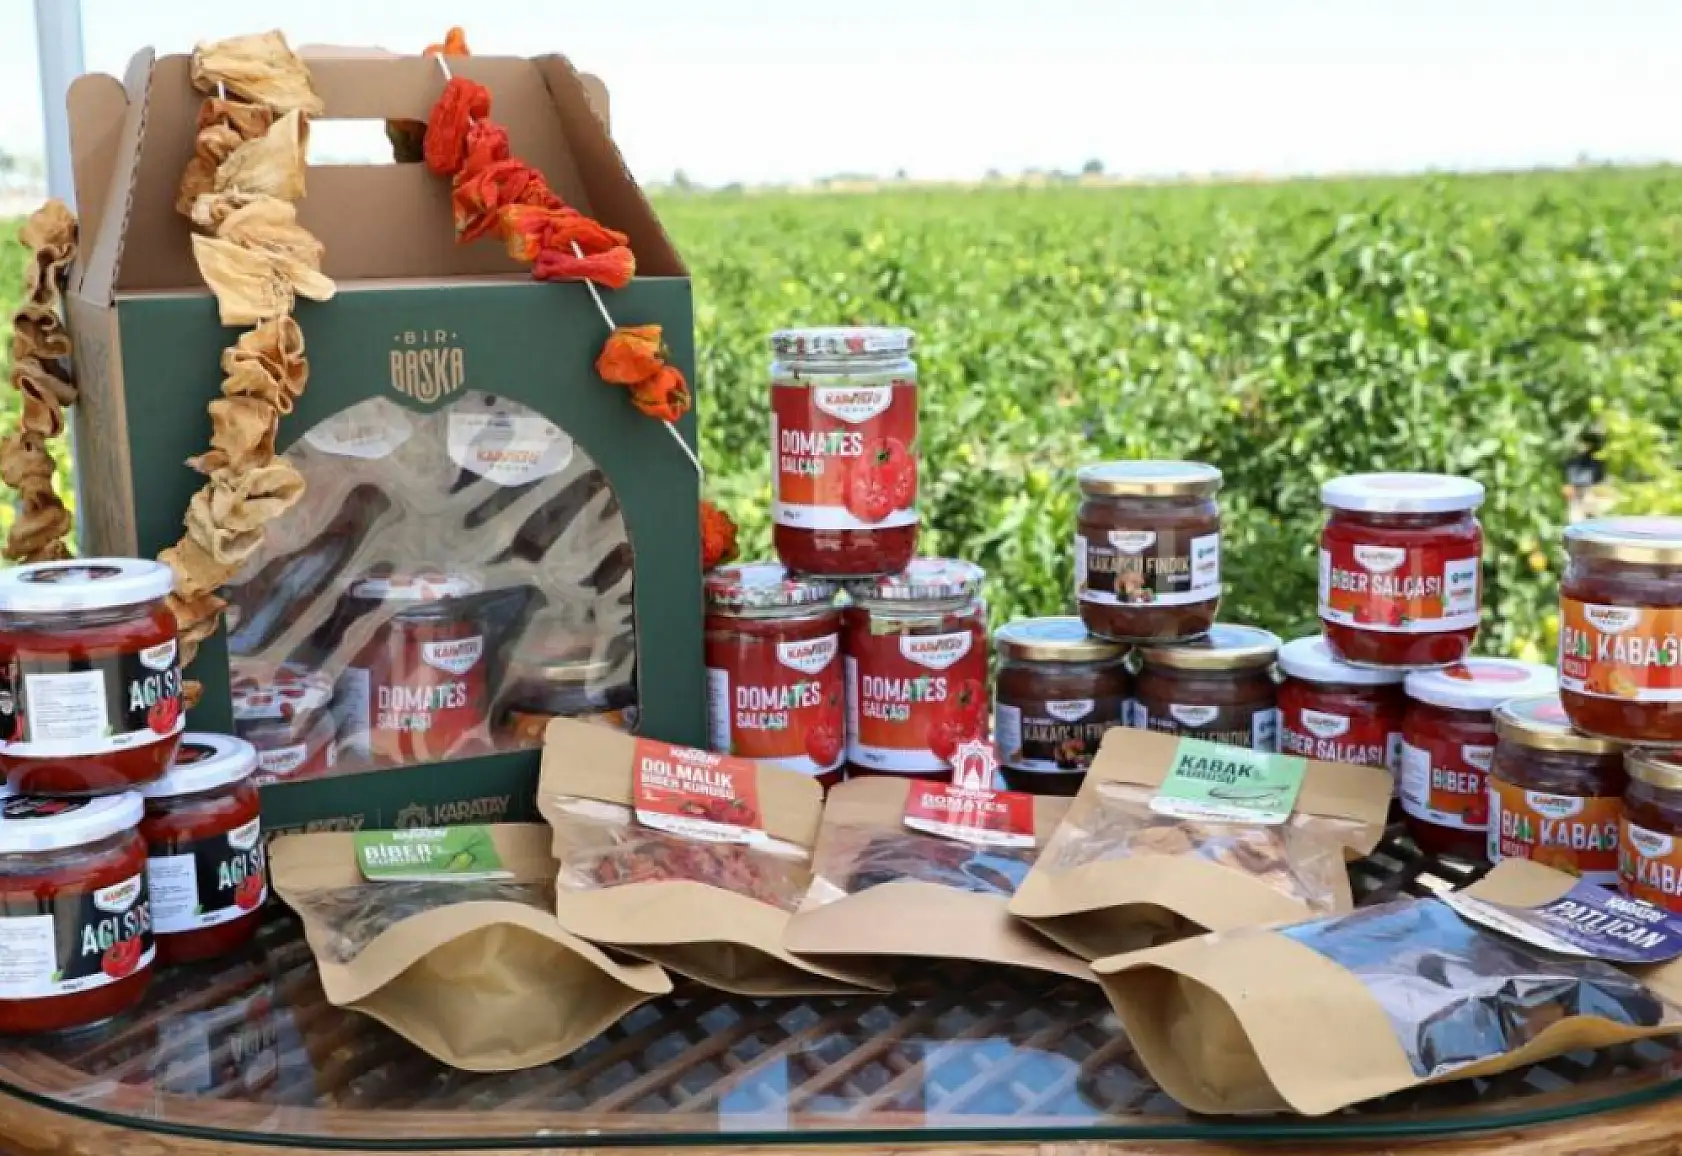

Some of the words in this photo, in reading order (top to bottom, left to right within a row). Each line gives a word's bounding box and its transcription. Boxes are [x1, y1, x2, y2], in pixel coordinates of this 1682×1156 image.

[781, 430, 863, 456] DOMATES
[378, 682, 467, 712] DOMATES
[736, 681, 821, 710] DOMATES
[862, 675, 948, 702] DOMATES
[642, 757, 733, 788] DOLMALIK
[1181, 754, 1255, 777] KABAK
